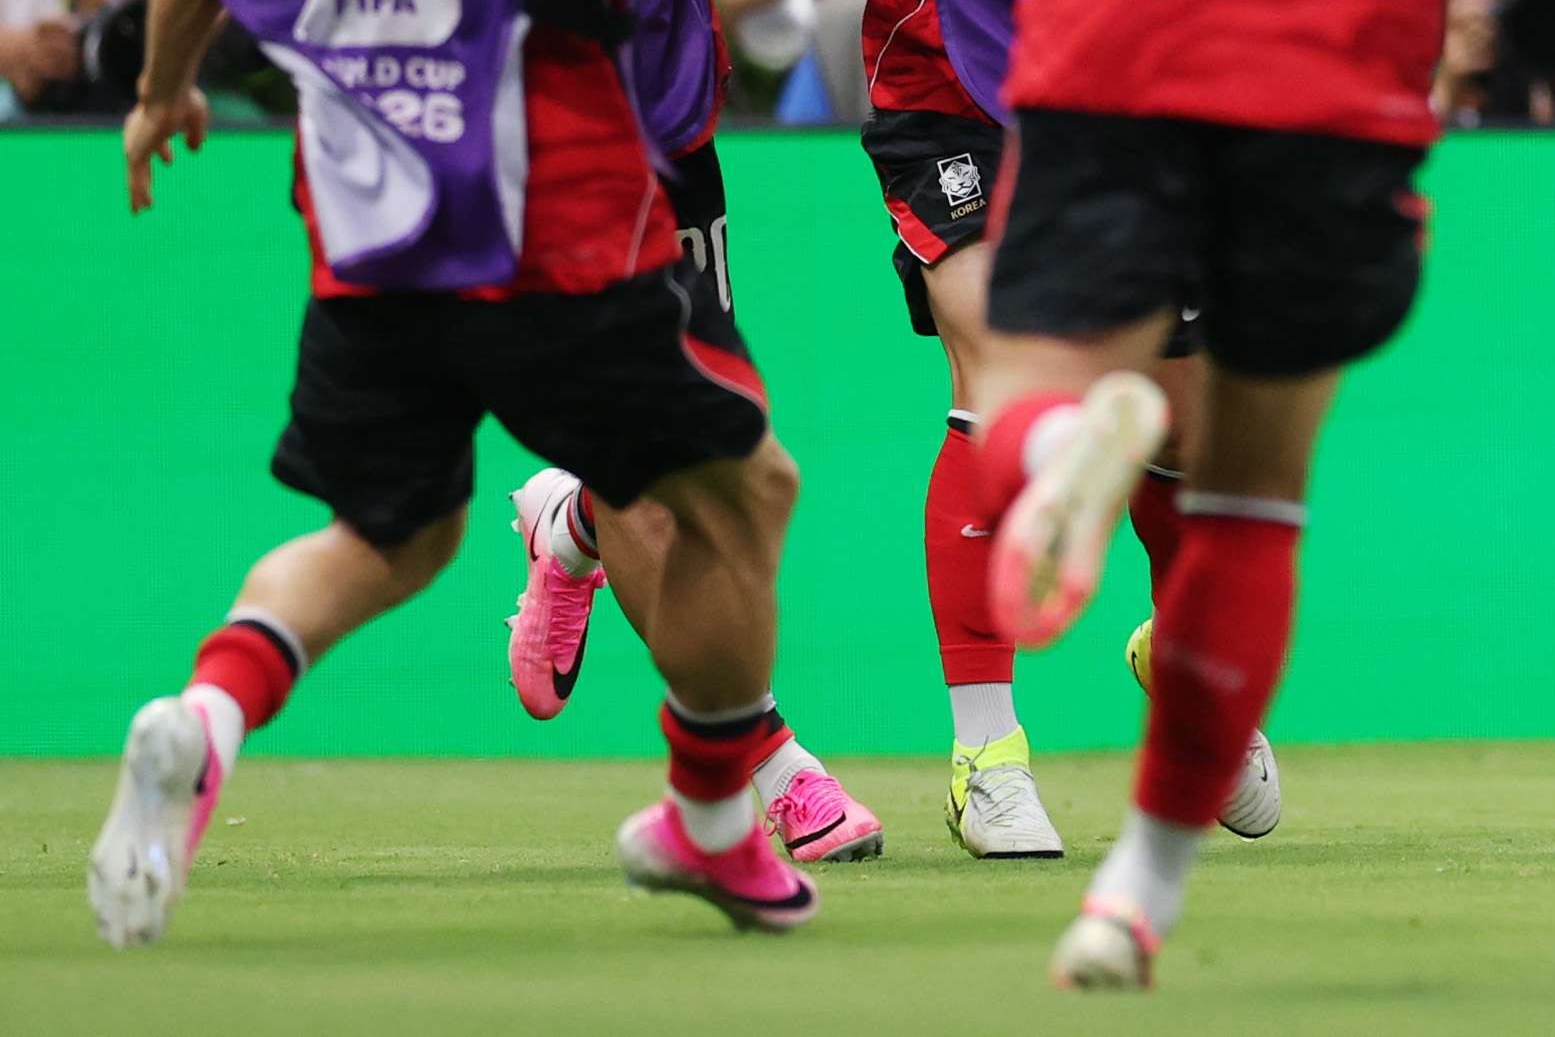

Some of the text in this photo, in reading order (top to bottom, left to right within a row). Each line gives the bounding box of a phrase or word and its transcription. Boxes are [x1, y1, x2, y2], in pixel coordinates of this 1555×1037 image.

[405, 56, 467, 91] CUP
[366, 89, 466, 143] 26
[950, 198, 987, 220] KOREA
